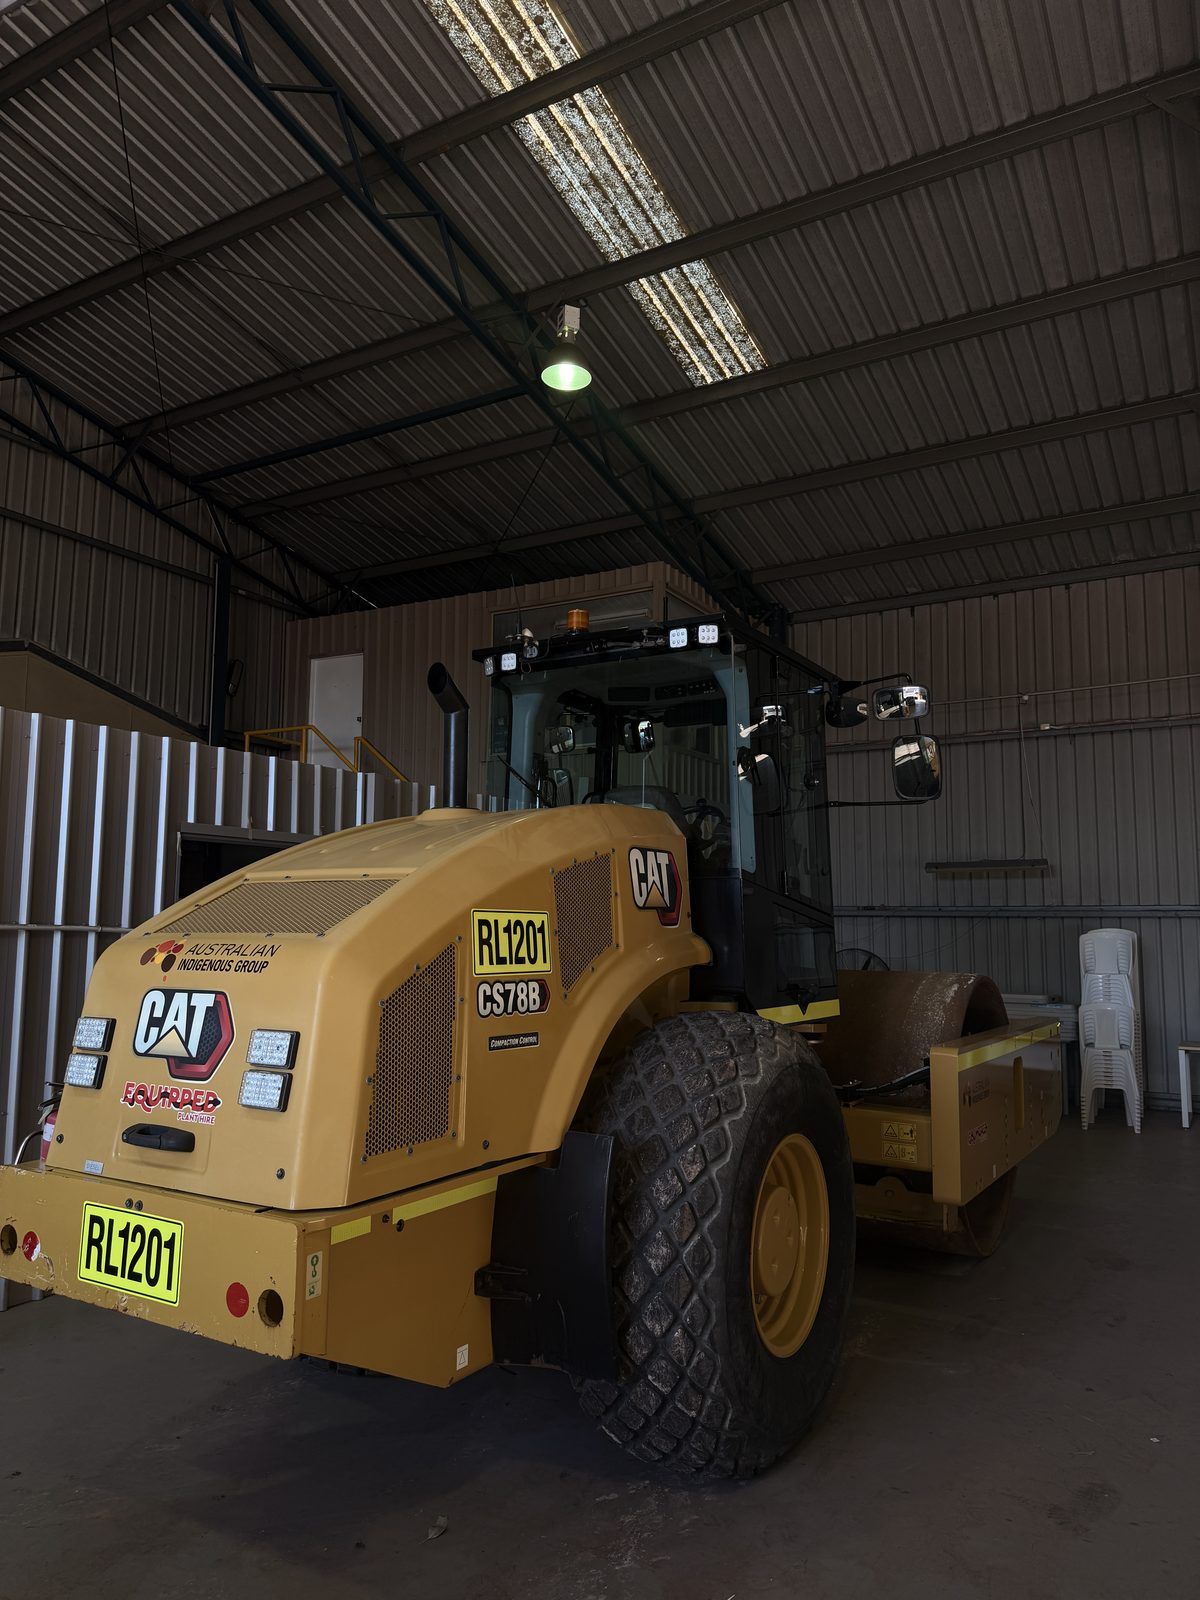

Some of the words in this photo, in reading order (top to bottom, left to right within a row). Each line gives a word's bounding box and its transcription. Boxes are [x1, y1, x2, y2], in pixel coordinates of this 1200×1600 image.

[629, 848, 670, 908] CAT
[185, 943, 281, 957] AUSTRALIAN
[477, 919, 547, 966] RL1201
[177, 958, 232, 973] INDIGENOUS
[234, 960, 269, 974] GROUP
[477, 981, 541, 1017] CS78B
[134, 990, 216, 1058] CAT
[490, 1037, 518, 1048] COMPACTION
[519, 1035, 537, 1045] CONTROL
[121, 1082, 222, 1114] EQUIPPED
[178, 1112, 198, 1122] PLANT
[199, 1115, 215, 1124] HIRE
[85, 1215, 176, 1291] RL1201
